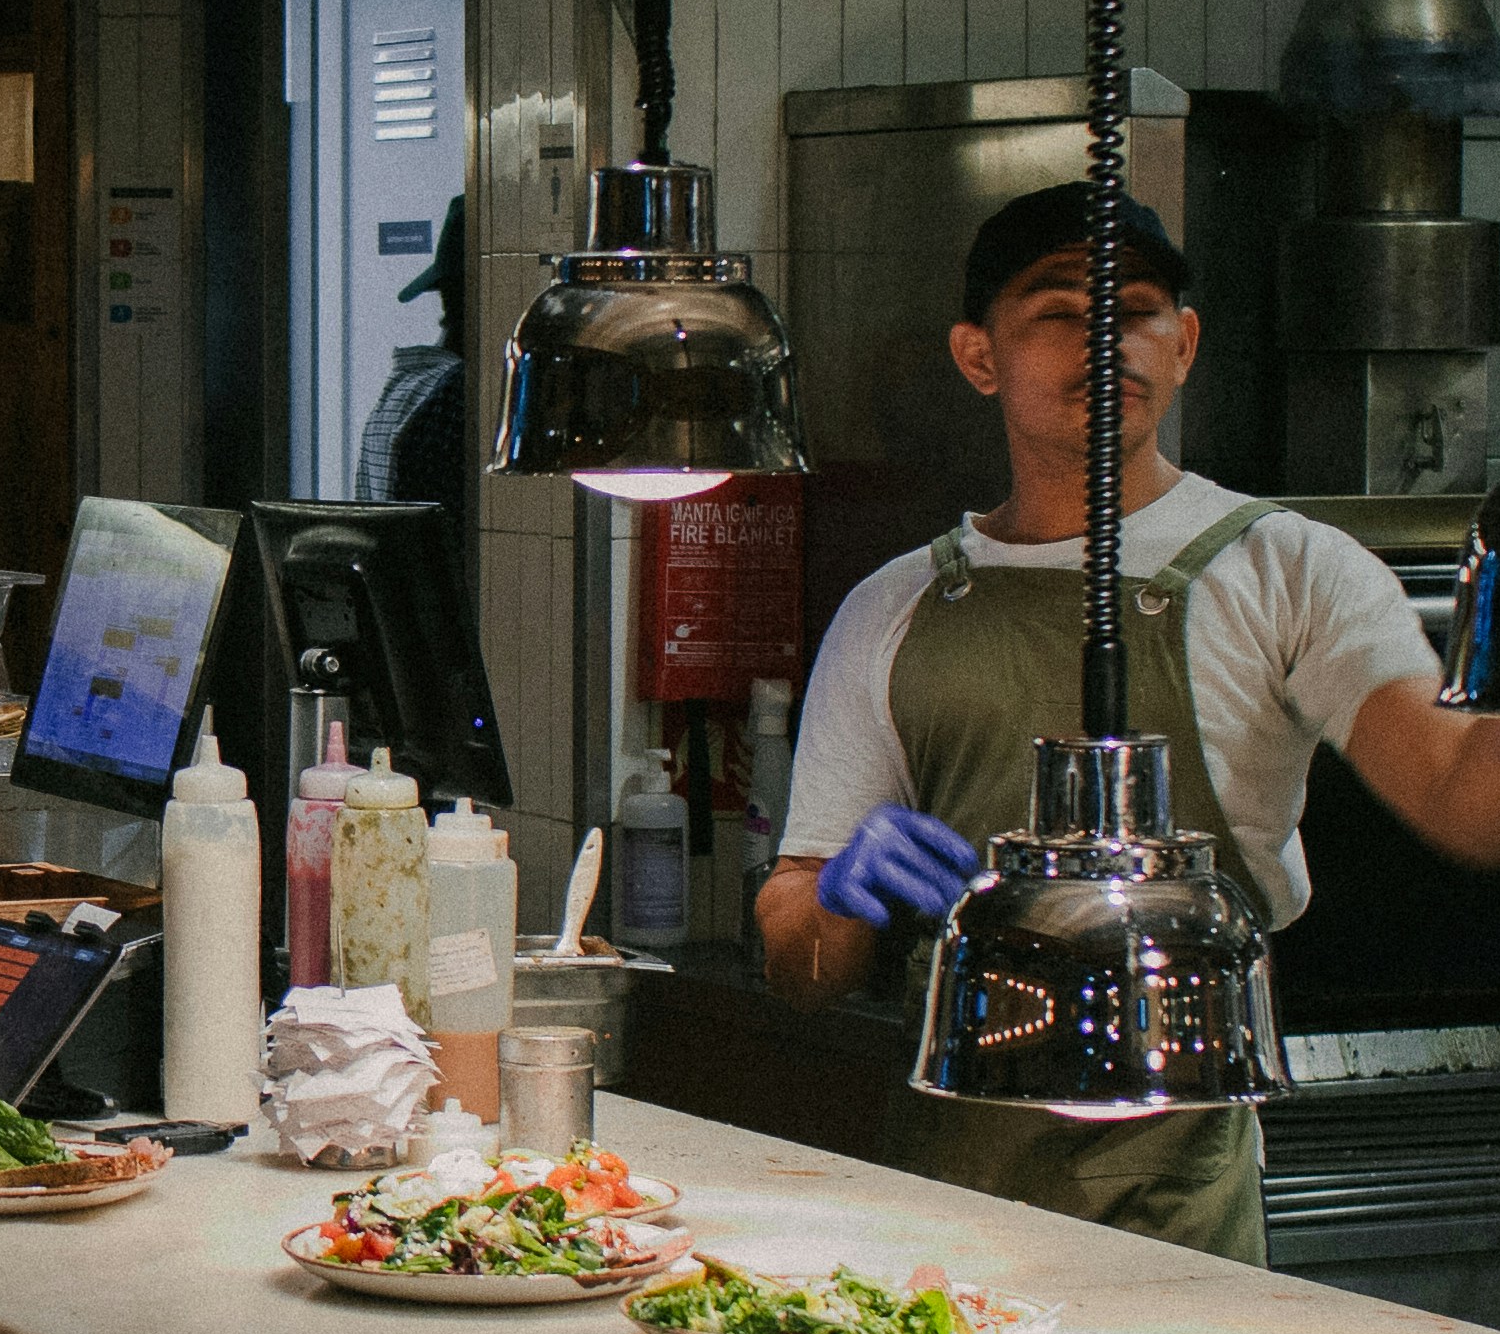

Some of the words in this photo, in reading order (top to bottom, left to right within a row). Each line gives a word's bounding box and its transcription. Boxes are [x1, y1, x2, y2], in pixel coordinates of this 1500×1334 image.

[671, 502, 722, 522] MANTA
[670, 525, 710, 544] FIRE
[714, 526, 798, 545] BLANKET
